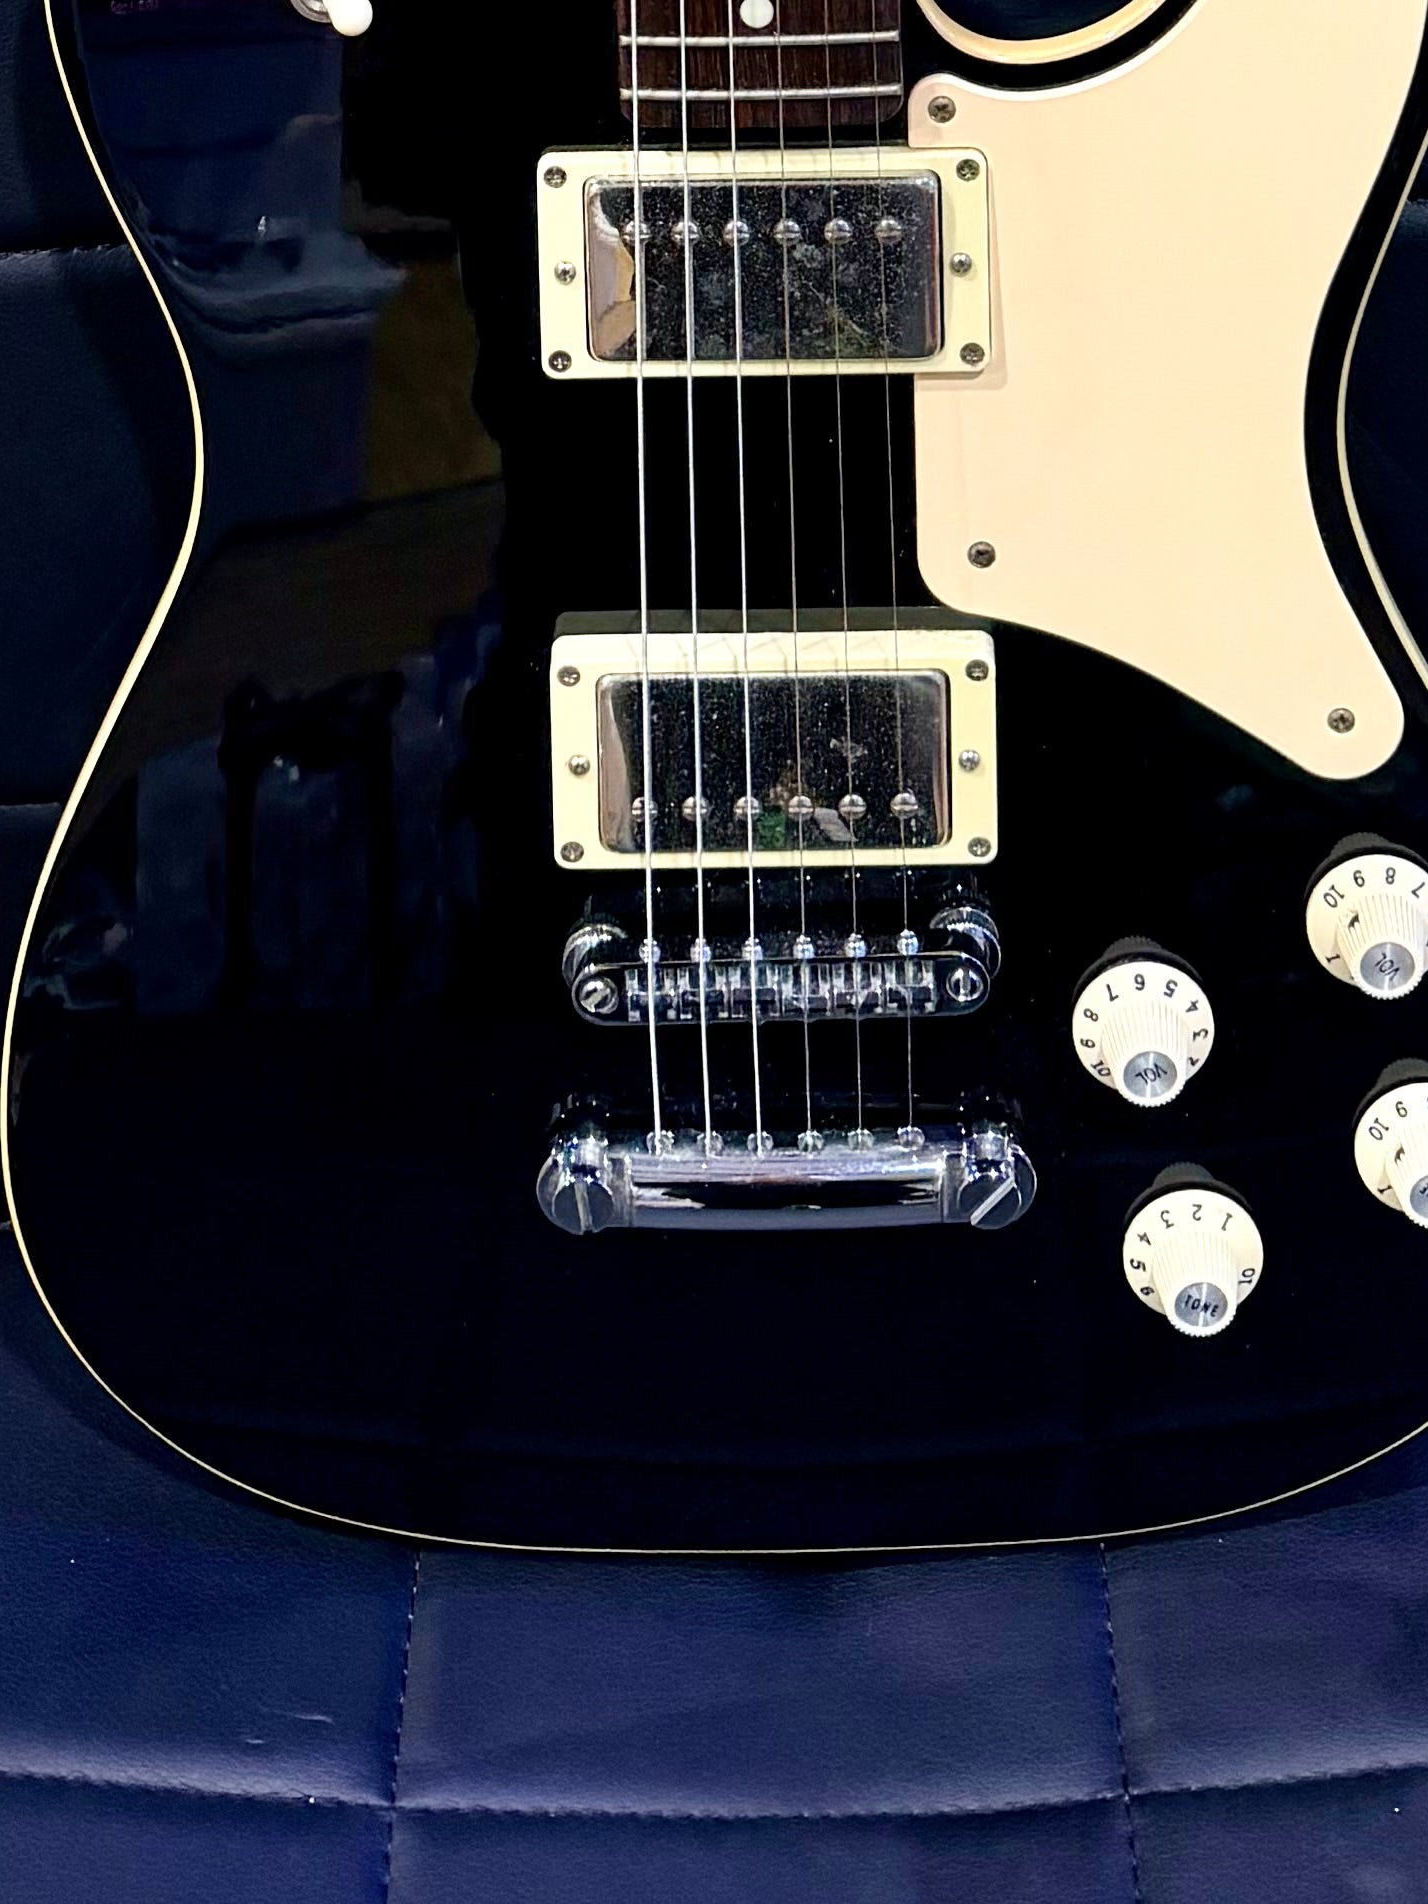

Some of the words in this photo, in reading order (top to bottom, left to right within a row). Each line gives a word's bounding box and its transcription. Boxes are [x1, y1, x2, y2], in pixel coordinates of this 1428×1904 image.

[1374, 952, 1401, 981] VOL
[1134, 1062, 1168, 1085] VOL
[1184, 1294, 1219, 1318] TONE
